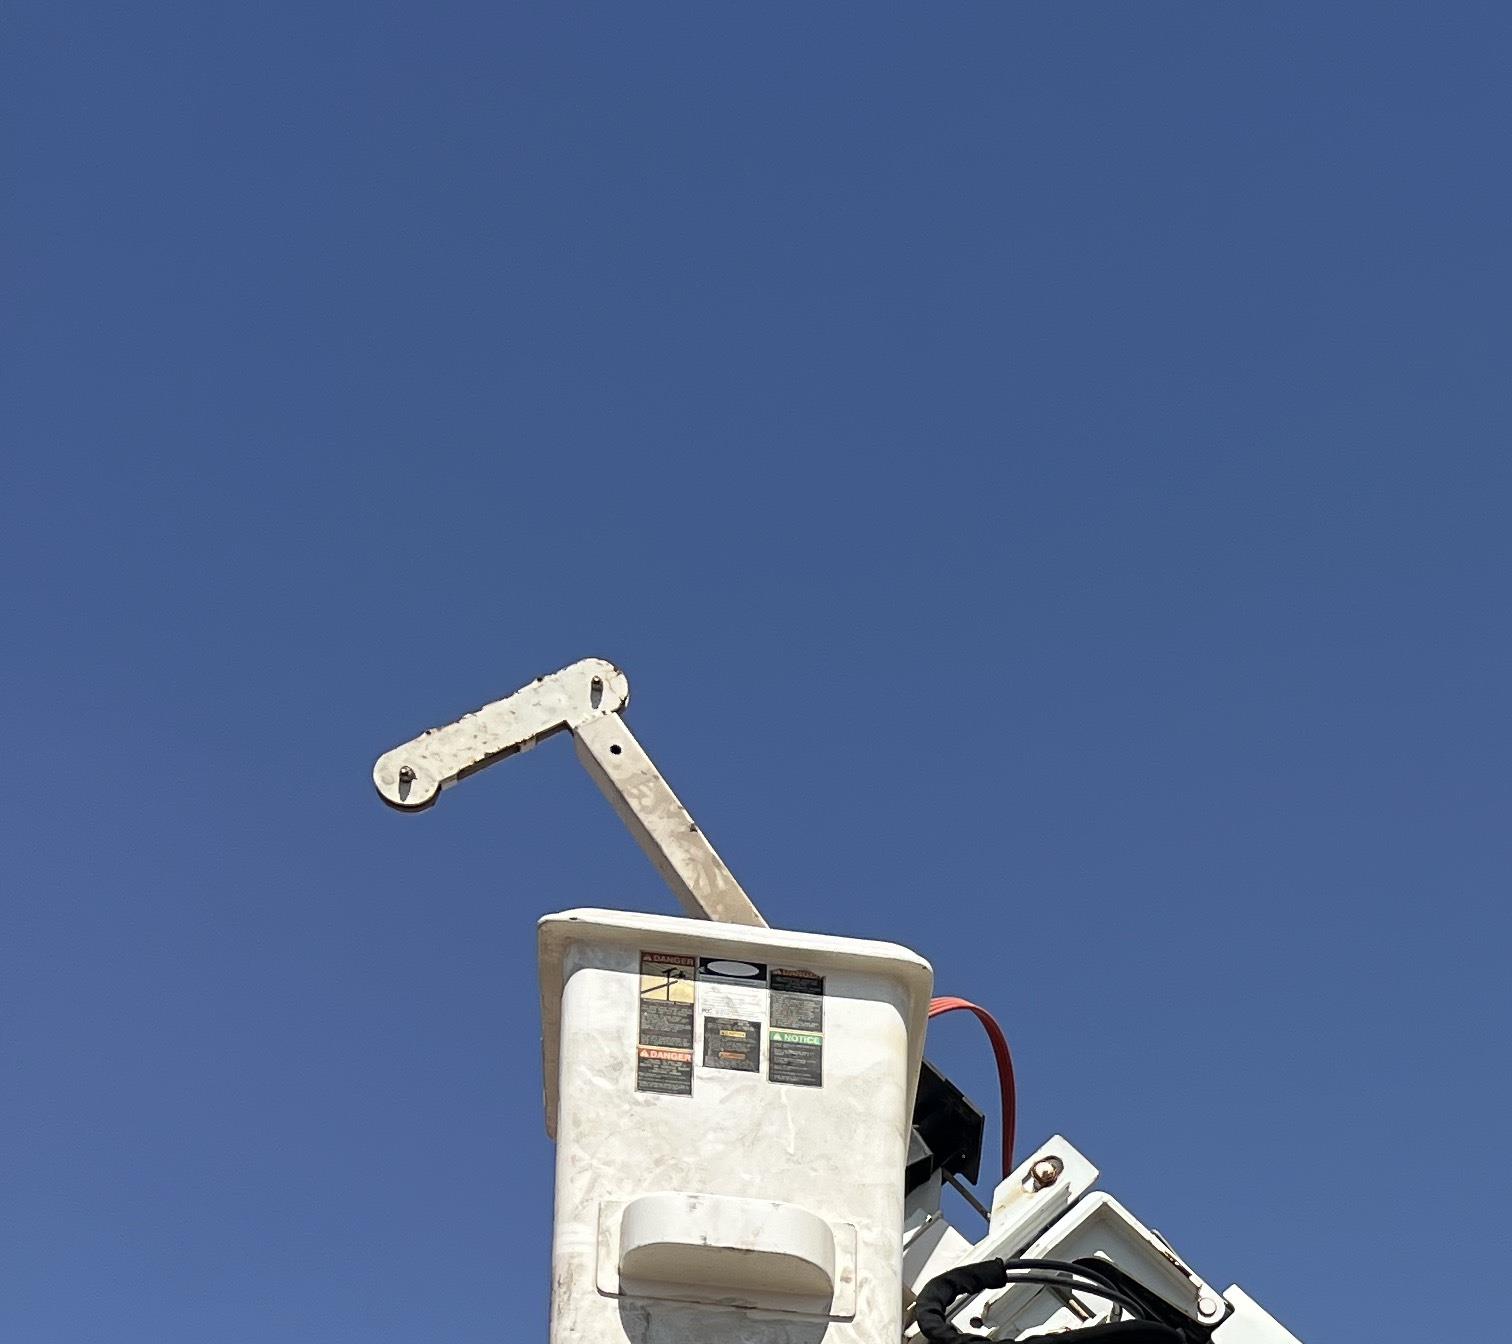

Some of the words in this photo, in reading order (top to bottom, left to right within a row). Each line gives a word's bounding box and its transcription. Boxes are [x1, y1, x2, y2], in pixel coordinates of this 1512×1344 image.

[653, 954, 694, 966] DANGER
[784, 1034, 821, 1045] NOTICE
[650, 1051, 691, 1062] DANGER
